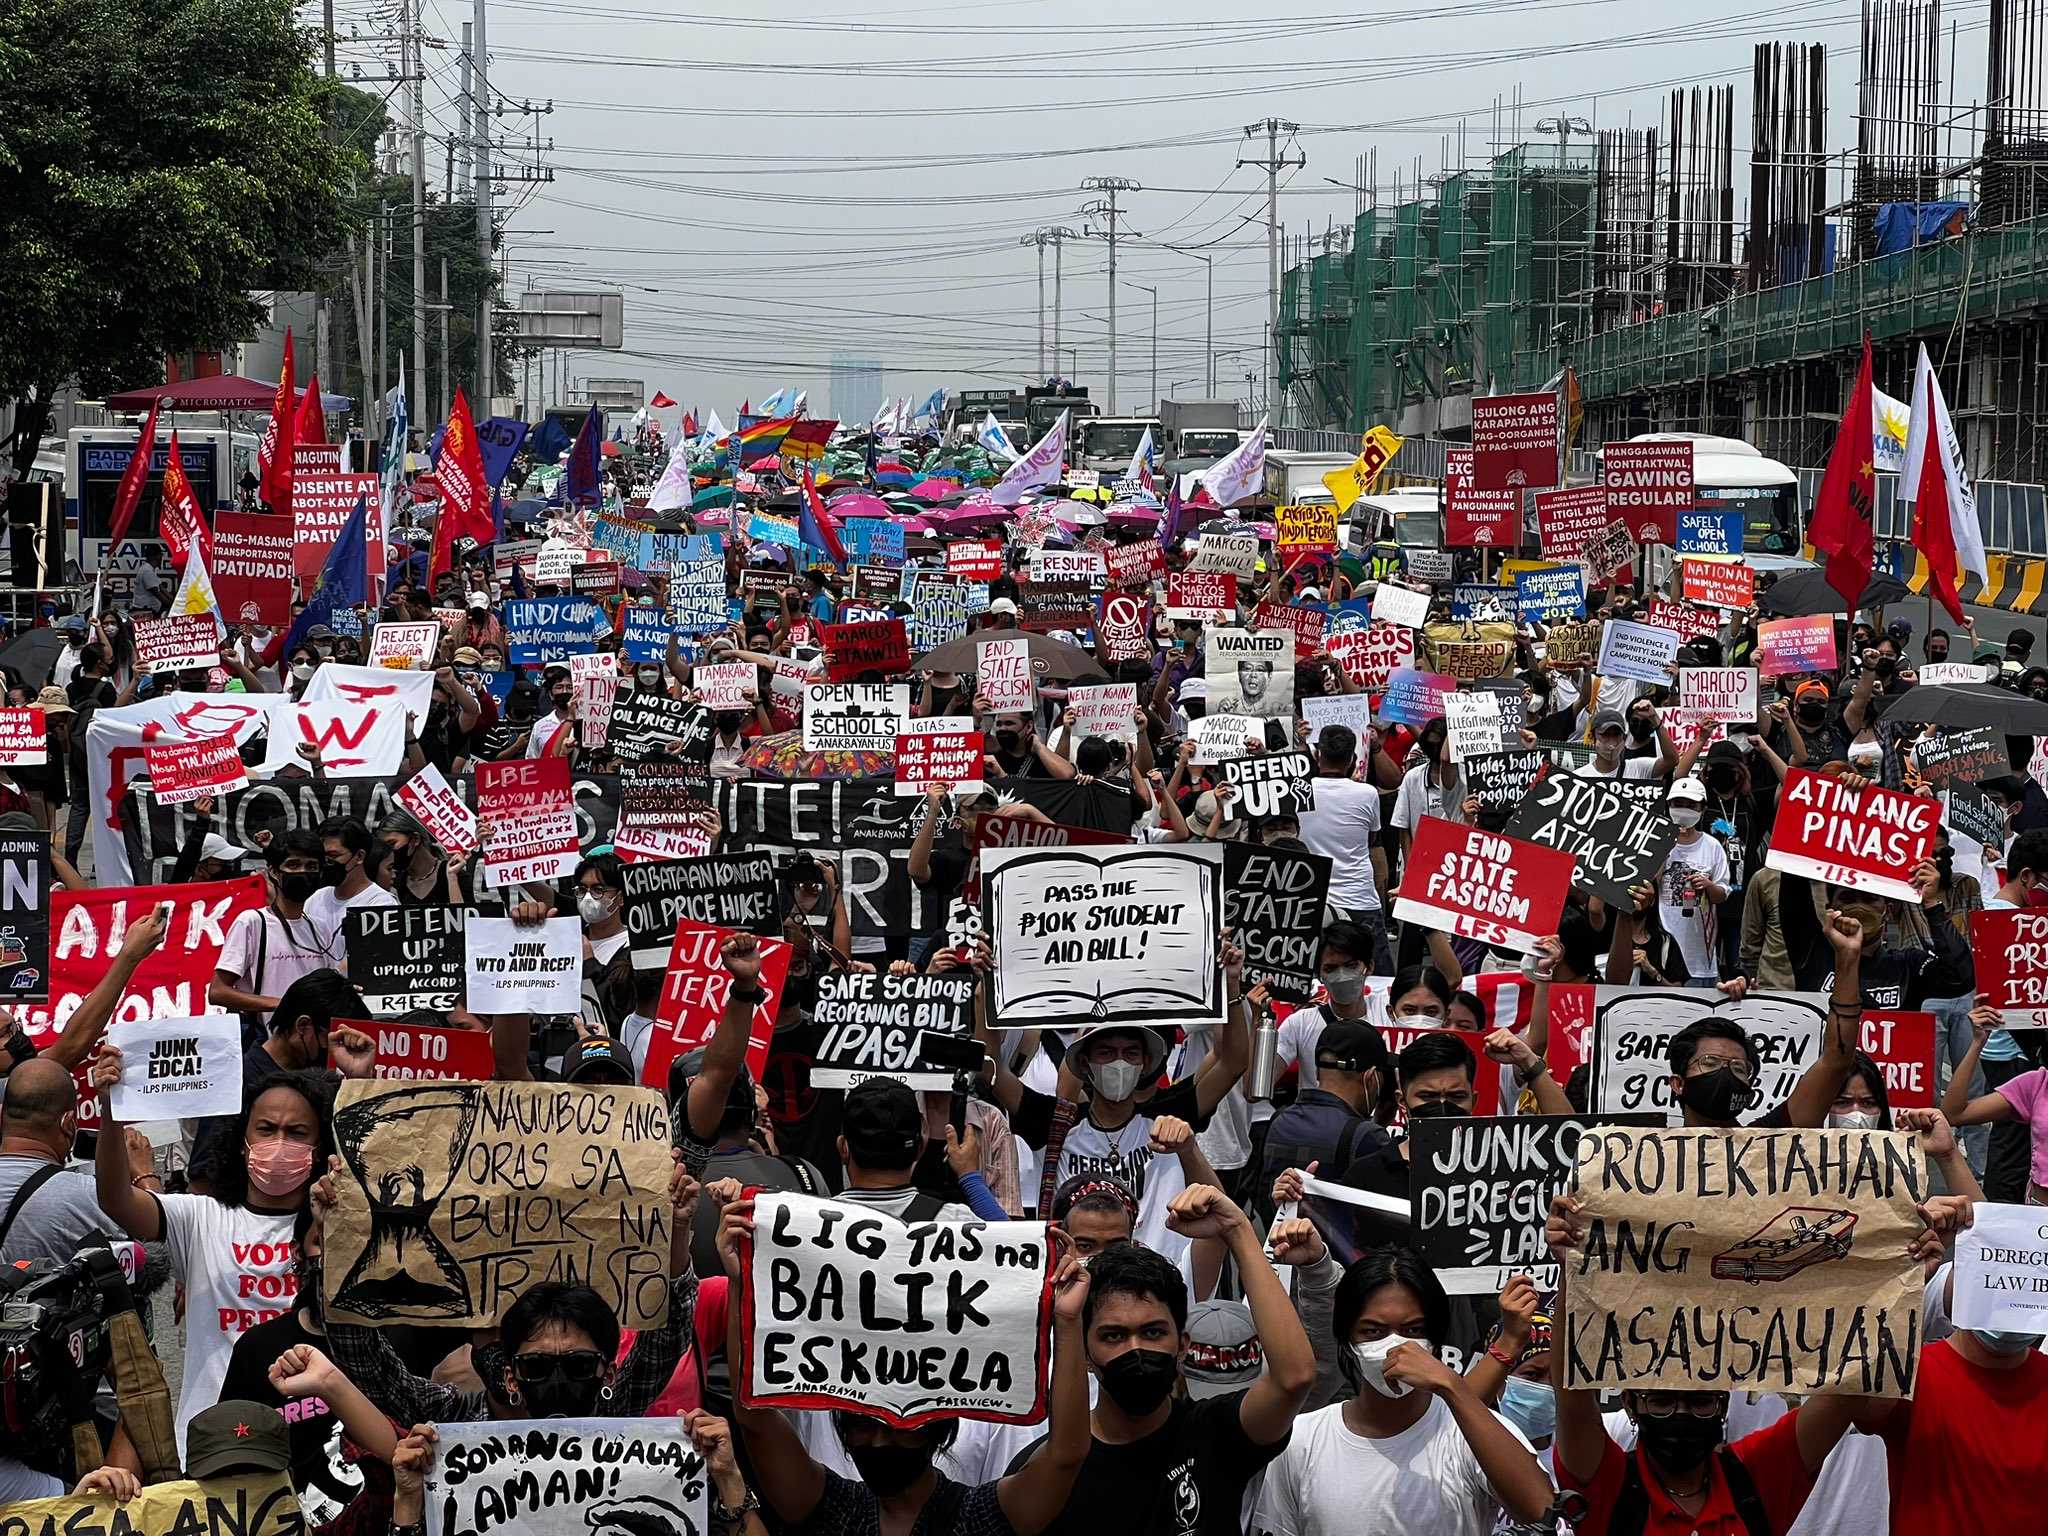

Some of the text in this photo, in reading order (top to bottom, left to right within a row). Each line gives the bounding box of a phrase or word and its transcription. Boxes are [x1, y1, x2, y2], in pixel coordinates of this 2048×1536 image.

[180, 397, 255, 407] MICROMATIC
[1474, 404, 1556, 418] ISULONG ANG
[1474, 415, 1556, 429] KARAPATAN SA
[1474, 428, 1556, 441] PAG-OORGANISA
[1475, 440, 1556, 452] AT PAG-UUNYON!
[1607, 446, 1690, 457] MANGGAGAWANG
[1607, 459, 1691, 469] KONTRAKTWAL,
[357, 479, 375, 493] AT
[1607, 471, 1691, 488] GAWING
[1454, 491, 1514, 500] SA LANGIS AT
[1608, 491, 1691, 506] REGULAR!
[1451, 502, 1515, 511] PANGUNAHING
[1553, 508, 1585, 520] ITIGIL
[1467, 513, 1501, 522] BILIHIN!
[1682, 516, 1722, 529] SAFELY
[215, 532, 293, 549] PANG-MASANG
[652, 535, 688, 549] NO TO
[1699, 528, 1725, 540] OPEN
[1203, 536, 1252, 552] MARCOS
[1682, 540, 1728, 553] SCHOOLS
[214, 547, 293, 561] TRANSPORTASYON,
[653, 549, 679, 561] FISH
[1201, 554, 1252, 571] ITAKWIL!
[213, 560, 293, 579] IPATUPAD!
[671, 563, 688, 575] NO
[1044, 556, 1098, 571] RESUME
[1687, 563, 1749, 581] NATIONAL
[672, 567, 725, 585] MANDATORY
[1169, 573, 1220, 591] REJECT
[671, 585, 704, 597] ROTC!
[917, 588, 967, 601] DEFEND
[1182, 585, 1225, 596] MARCOS
[1706, 588, 1737, 602] NOW
[671, 599, 727, 613] PHILIPPINE
[1181, 595, 1225, 607] DUTERTE
[512, 604, 559, 625] HINDI
[671, 611, 719, 624] HISTORY
[915, 606, 968, 625] ACADEMIC
[1266, 604, 1322, 623] JUSTICE FOR
[1655, 603, 1717, 626] LIGTAS NA
[1258, 616, 1296, 630] JENNIFER
[381, 629, 429, 643] REJECT
[915, 624, 967, 643] FREEDOM
[1327, 629, 1413, 656] MARCOS
[1615, 632, 1664, 647] END VIOLENCE
[985, 642, 1014, 658] END
[1216, 637, 1284, 651] WANTED
[1439, 643, 1505, 655] DEFEND
[1614, 641, 1668, 659] IMPUNITY! SAFE
[155, 658, 195, 670] DIWA
[980, 658, 1024, 679] STATE
[1451, 655, 1495, 666] PRESS
[1610, 651, 1666, 669] CAMPUSES NOW
[699, 665, 753, 680] TAMARAWS
[1439, 664, 1500, 678] FREEDOM
[1924, 666, 1978, 680] ITAKWIL
[980, 679, 1031, 698] FASCISM
[1687, 670, 1748, 693] MARCOS
[810, 684, 894, 702] OPEN THE
[1684, 693, 1739, 708] ITAKWIL!
[612, 709, 709, 742] OIL PRICE HIKE
[907, 736, 966, 751] OIL PRICE
[899, 750, 978, 765] HIKE, PAHIRAP
[485, 764, 540, 788] LBE
[906, 762, 969, 778] SA MASA!
[1226, 757, 1310, 782] DEFEND
[1537, 774, 1621, 830] STOP
[1788, 776, 1858, 816] ATIN
[1866, 793, 1929, 833] ANG
[411, 773, 481, 853] IMPUNITY
[853, 829, 905, 839] ANAKBAYAN
[1618, 805, 1670, 856] THE
[1802, 812, 1926, 866] PINAS!
[616, 827, 708, 857] LIBEL NOW!
[1466, 832, 1511, 860] END
[1531, 818, 1639, 883] ATTACKS
[499, 860, 560, 883] R4E PUP
[623, 859, 773, 894] KABATAAN KONTRA
[1238, 855, 1316, 892] END
[1441, 853, 1518, 892] STATE
[1824, 865, 1857, 886] LFS
[1044, 880, 1138, 903] PASS THE
[1427, 876, 1530, 924] FASCISM
[628, 893, 773, 933] OIL PRICE HIKE!
[1085, 903, 1185, 930] STUDENT
[1454, 915, 1508, 940] LFS
[402, 938, 445, 960] UP!
[508, 943, 546, 958] JUNK
[1044, 931, 1149, 964] AID BILL!
[373, 963, 459, 976] UPHOLD UP
[475, 956, 575, 972] WTO AND RCEP!
[818, 973, 973, 1002] SAFE SCHOOLS
[381, 995, 456, 1010] R4E-CS
[814, 1001, 966, 1030] REOPENING BILL
[150, 1038, 199, 1060] JUNK
[379, 1031, 447, 1061] NO TO
[148, 1057, 203, 1079] EDCA!
[143, 1080, 208, 1094] ILPS PHILIPPINES
[480, 1087, 667, 1142] NAUUBOS ANG
[1432, 1125, 1549, 1176] JUNK
[468, 1142, 632, 1197] ORAS SA
[1574, 1128, 1927, 1199] PROTEKTAHAN
[796, 1164, 812, 1190] Nikon
[451, 1195, 672, 1247] BULOK NA
[994, 1242, 1039, 1268] na
[1579, 1219, 1696, 1275] ANG
[1983, 1273, 2022, 1292] LAW
[771, 1257, 991, 1334] BALIK
[1567, 1305, 1918, 1394] KASAYSAYAN
[763, 1332, 1011, 1394] ESKWELA
